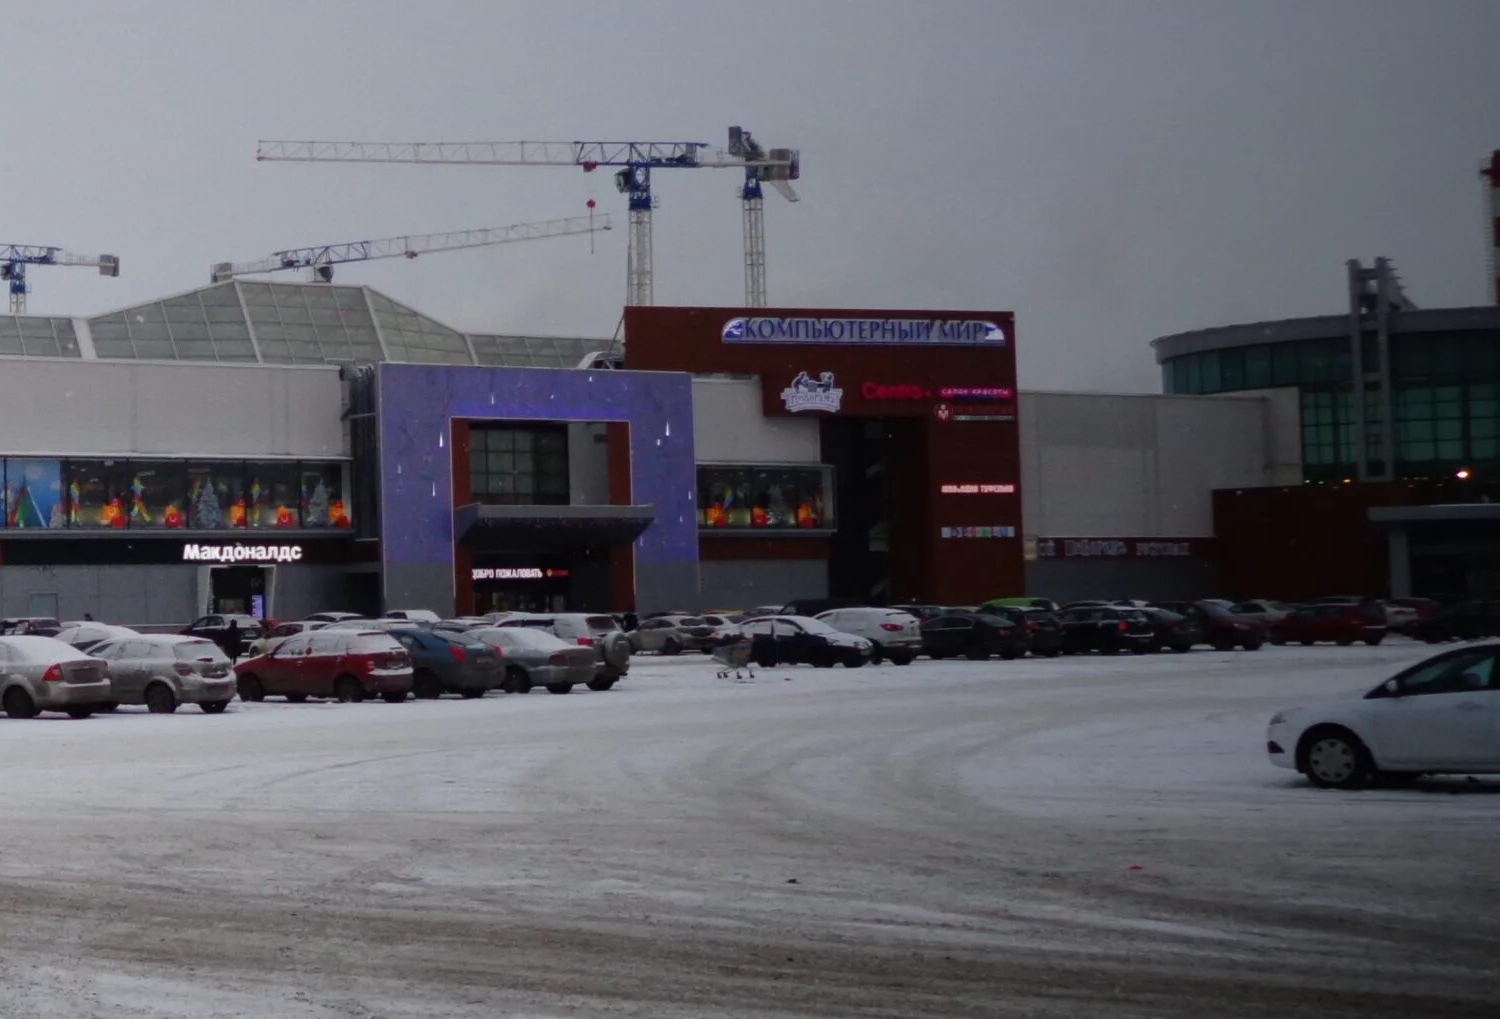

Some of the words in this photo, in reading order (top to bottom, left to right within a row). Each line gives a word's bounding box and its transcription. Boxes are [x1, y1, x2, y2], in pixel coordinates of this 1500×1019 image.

[746, 319, 932, 340] КОМПЬЮТЕРНЫЙ
[933, 320, 988, 341] МИР
[182, 544, 303, 563] Макдоналдс
[495, 568, 543, 579] ПОЖАЛОВАТЬ
